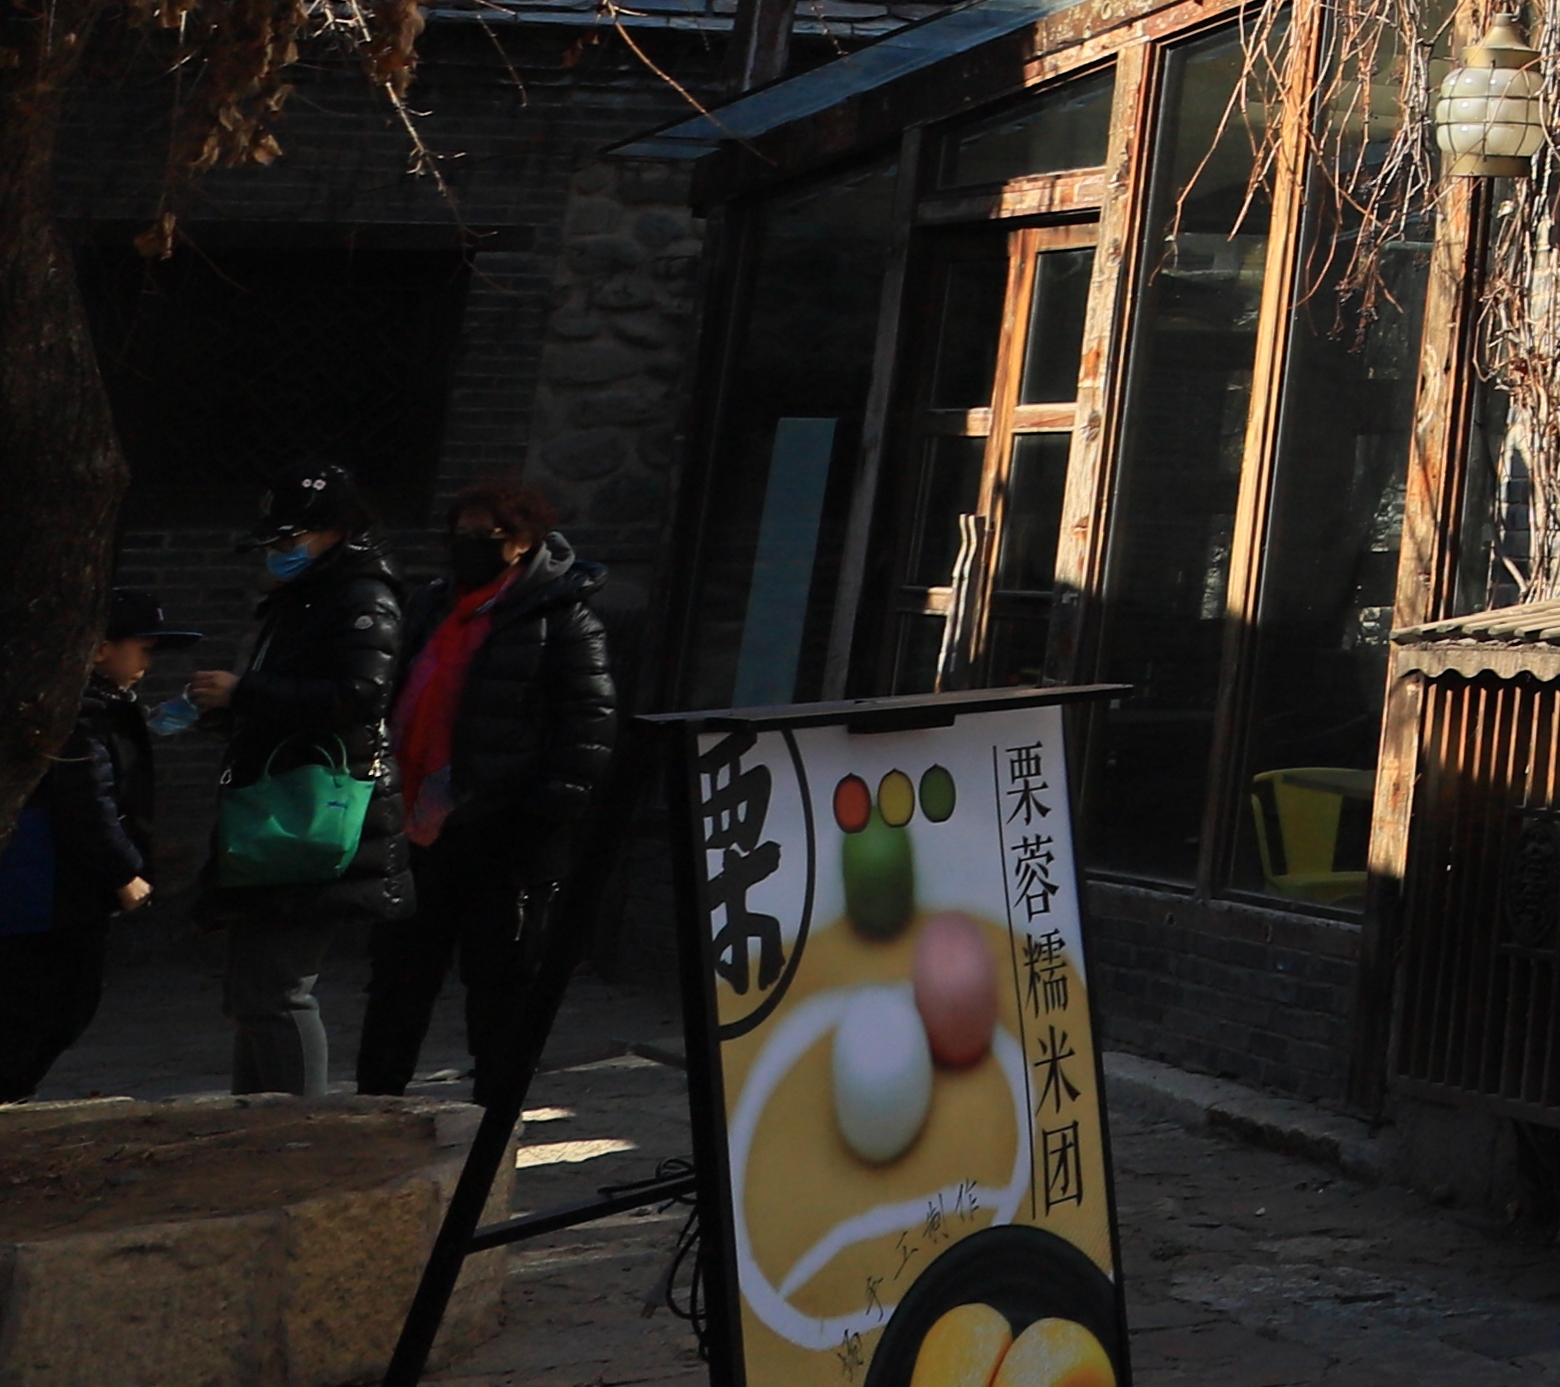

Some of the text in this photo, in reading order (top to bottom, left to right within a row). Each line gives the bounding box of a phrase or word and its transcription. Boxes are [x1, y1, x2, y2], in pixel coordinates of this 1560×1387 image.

[1003, 740, 1084, 1219] 栗蓉糯米团
